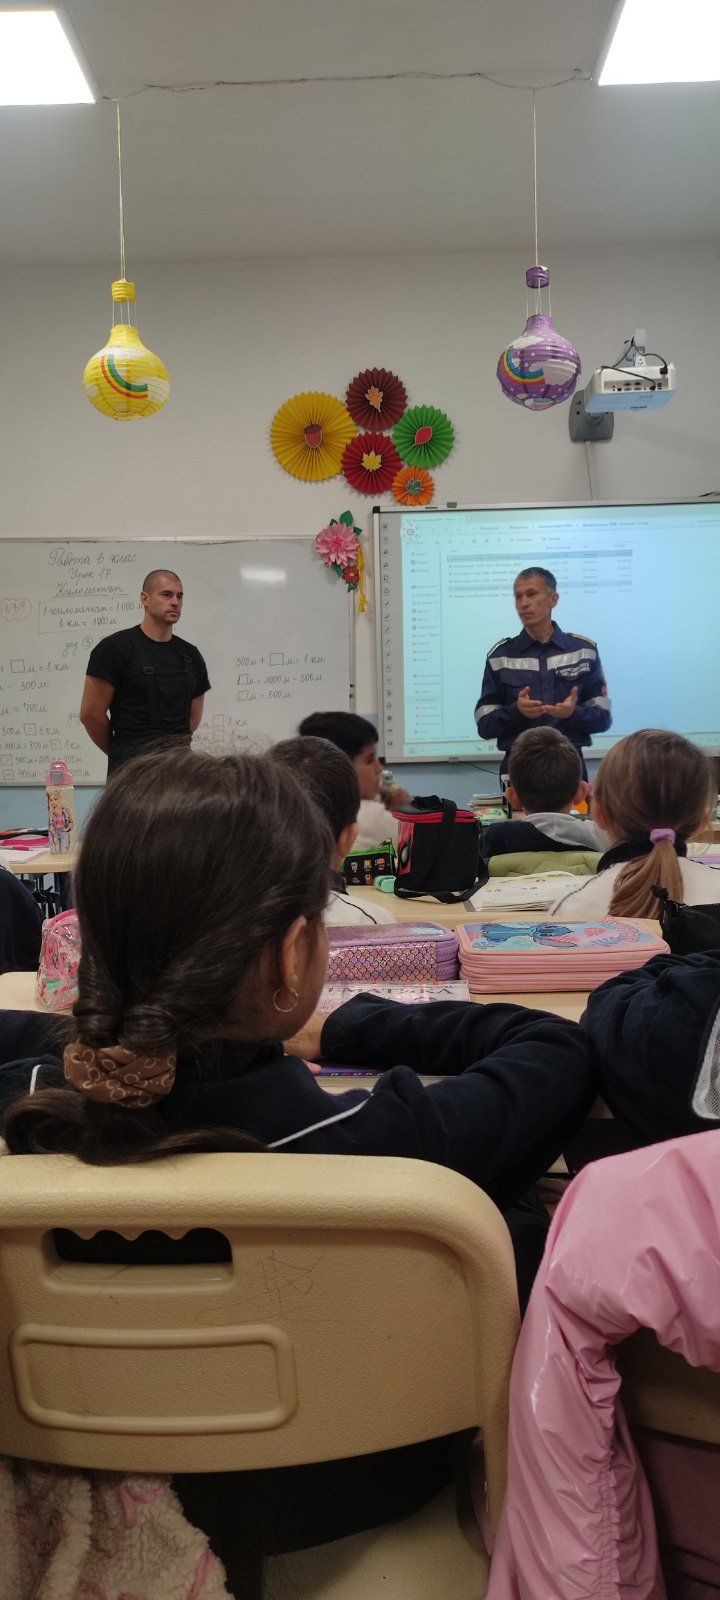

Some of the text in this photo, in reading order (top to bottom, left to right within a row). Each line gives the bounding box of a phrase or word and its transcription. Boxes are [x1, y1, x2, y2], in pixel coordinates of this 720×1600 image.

[48, 547, 90, 566] Работа
[110, 554, 136, 564] клас
[70, 567, 112, 586] Урок 17
[56, 582, 124, 600] Километър
